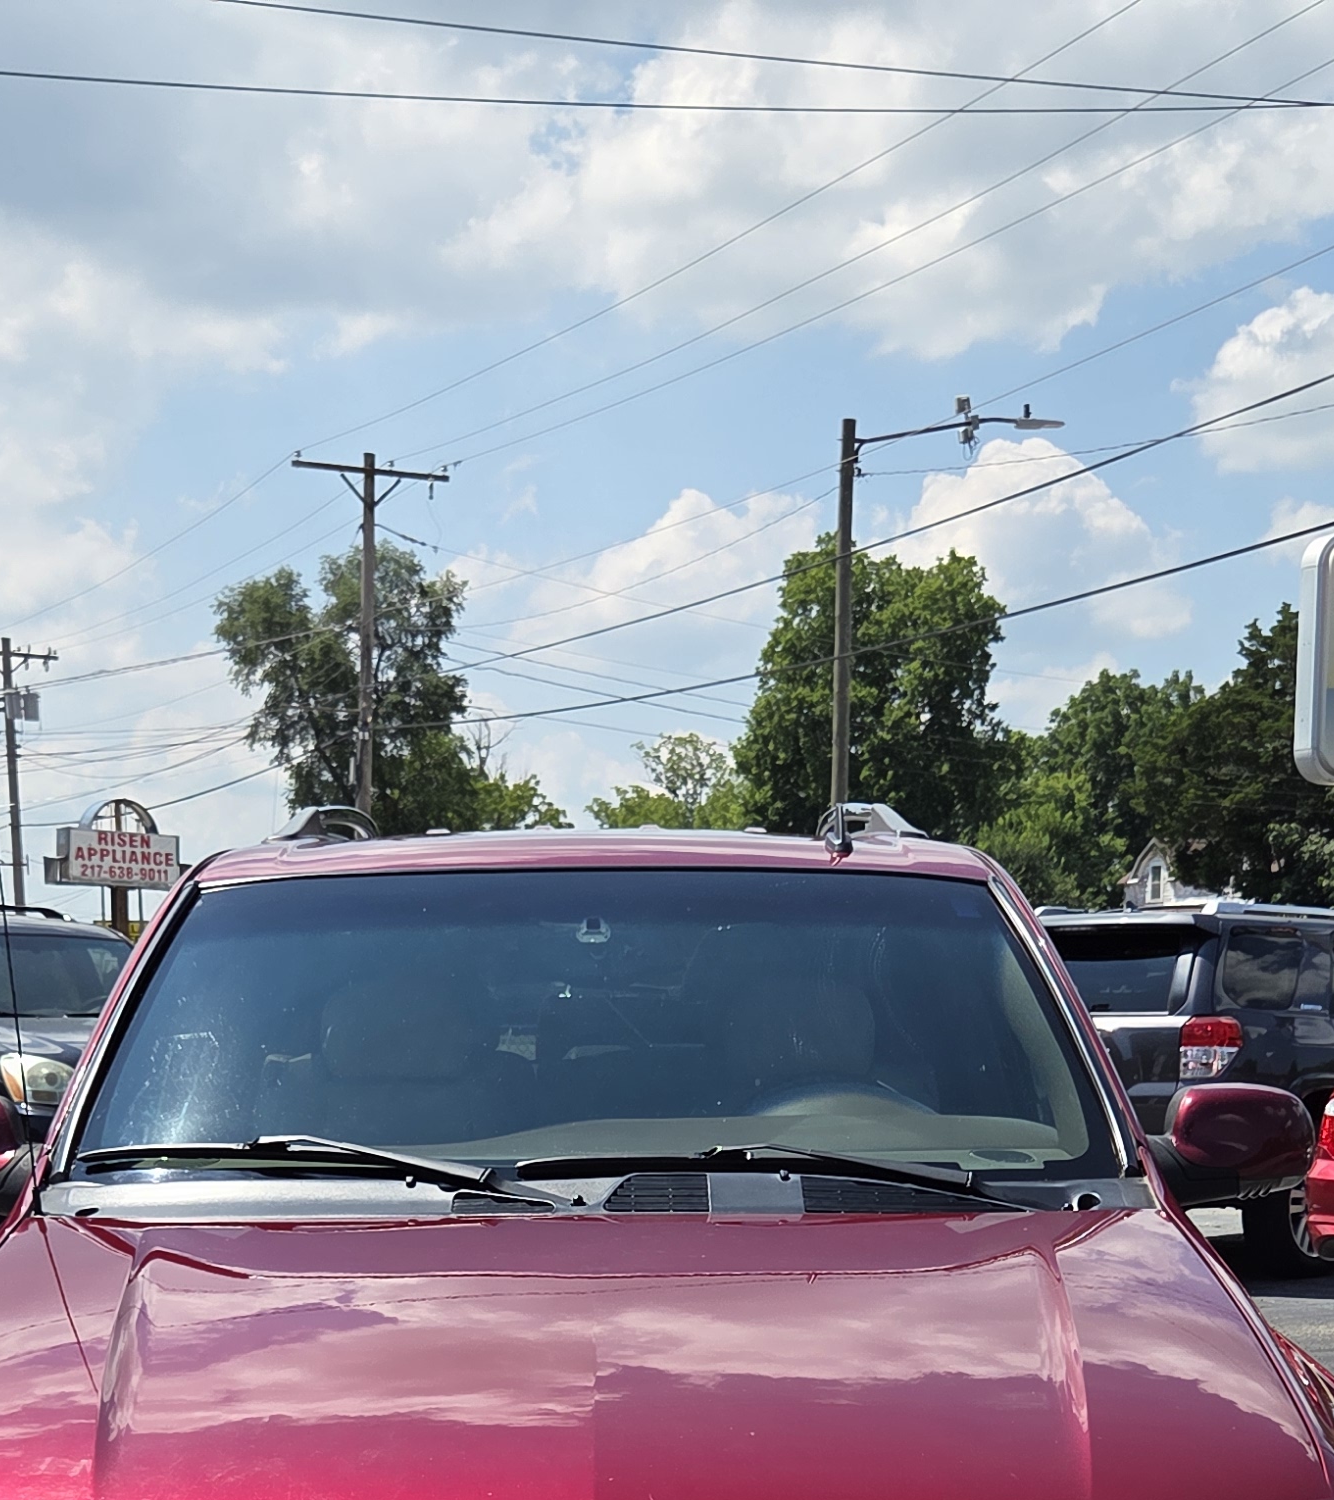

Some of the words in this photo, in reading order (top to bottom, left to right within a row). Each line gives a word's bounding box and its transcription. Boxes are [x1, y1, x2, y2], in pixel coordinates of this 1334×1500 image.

[97, 831, 152, 849] RISEN
[74, 846, 175, 867] APPLIANCE
[80, 863, 169, 882] 217-638-9011
